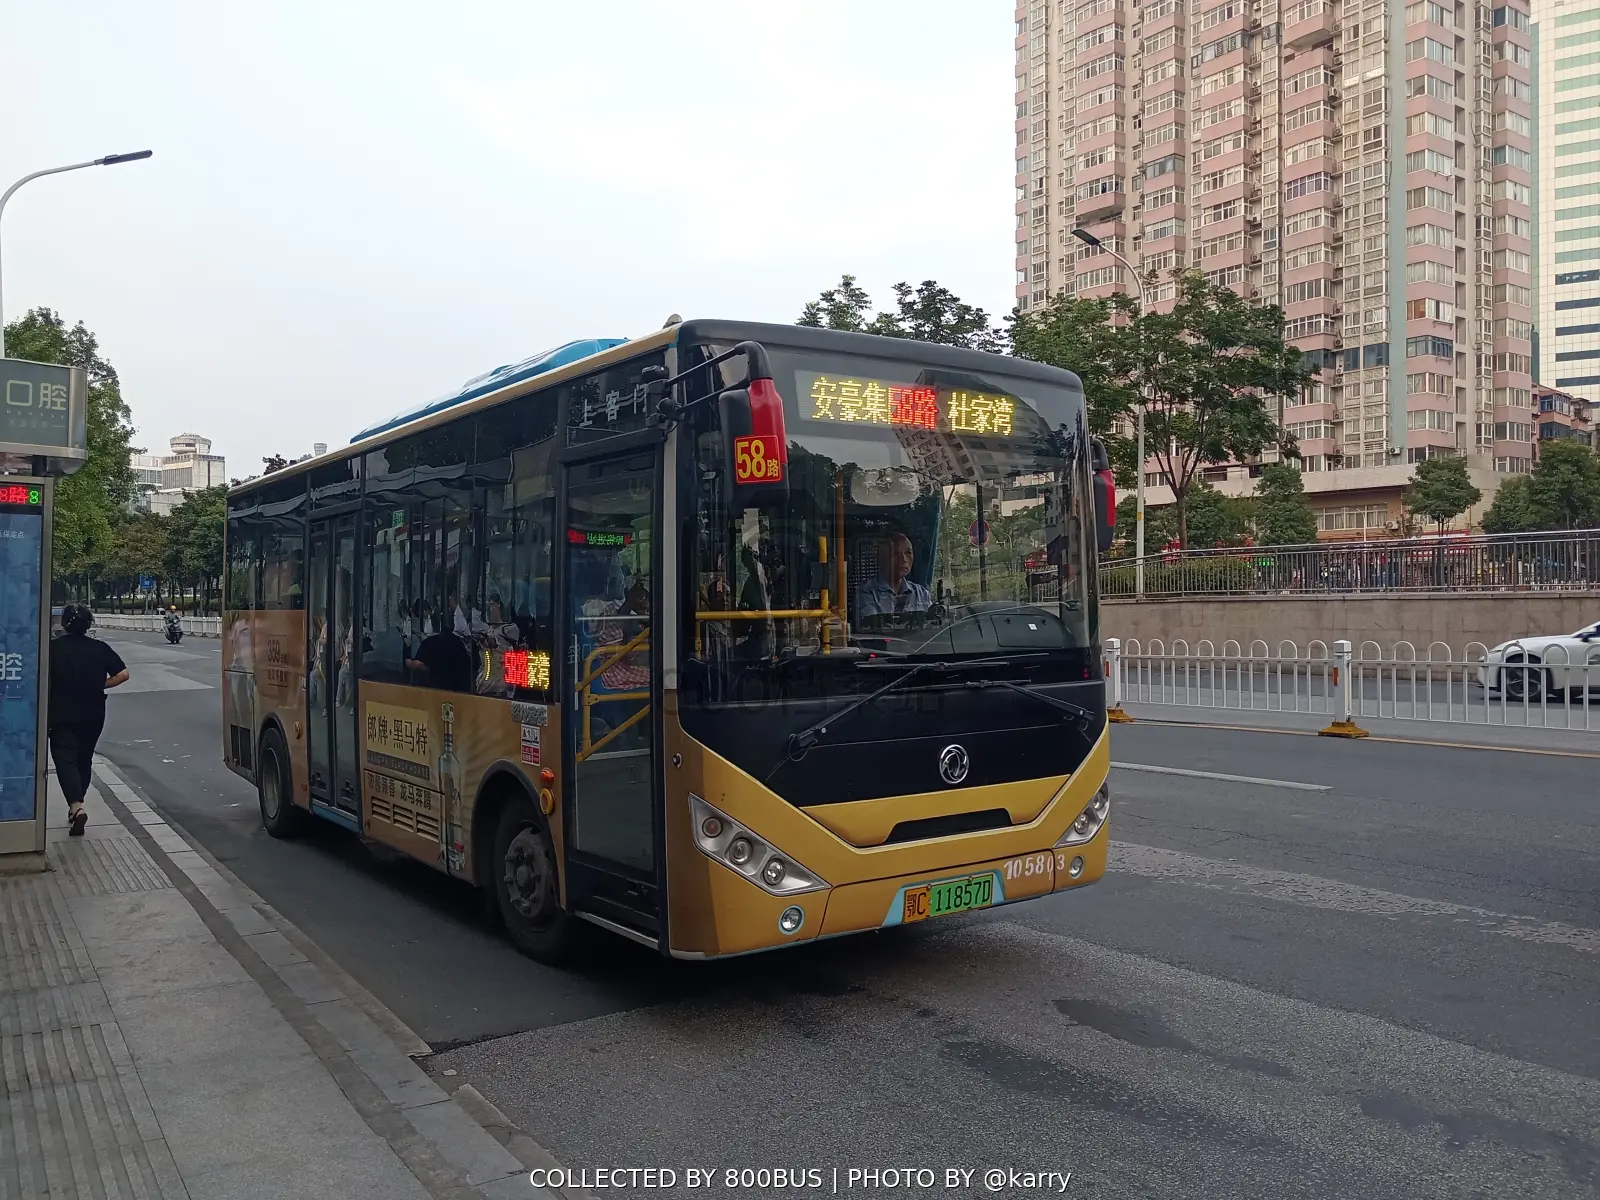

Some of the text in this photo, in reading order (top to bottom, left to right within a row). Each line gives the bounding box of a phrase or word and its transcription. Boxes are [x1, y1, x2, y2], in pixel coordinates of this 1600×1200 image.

[6, 379, 67, 411] 口腔
[579, 383, 648, 427] 上客门
[811, 377, 891, 425] 安豪集
[948, 391, 1014, 436] 杜家湾
[736, 439, 780, 481] 58路
[0, 530, 25, 539] 保定点
[1003, 854, 1065, 880] 105803
[935, 879, 991, 912] 11857D
